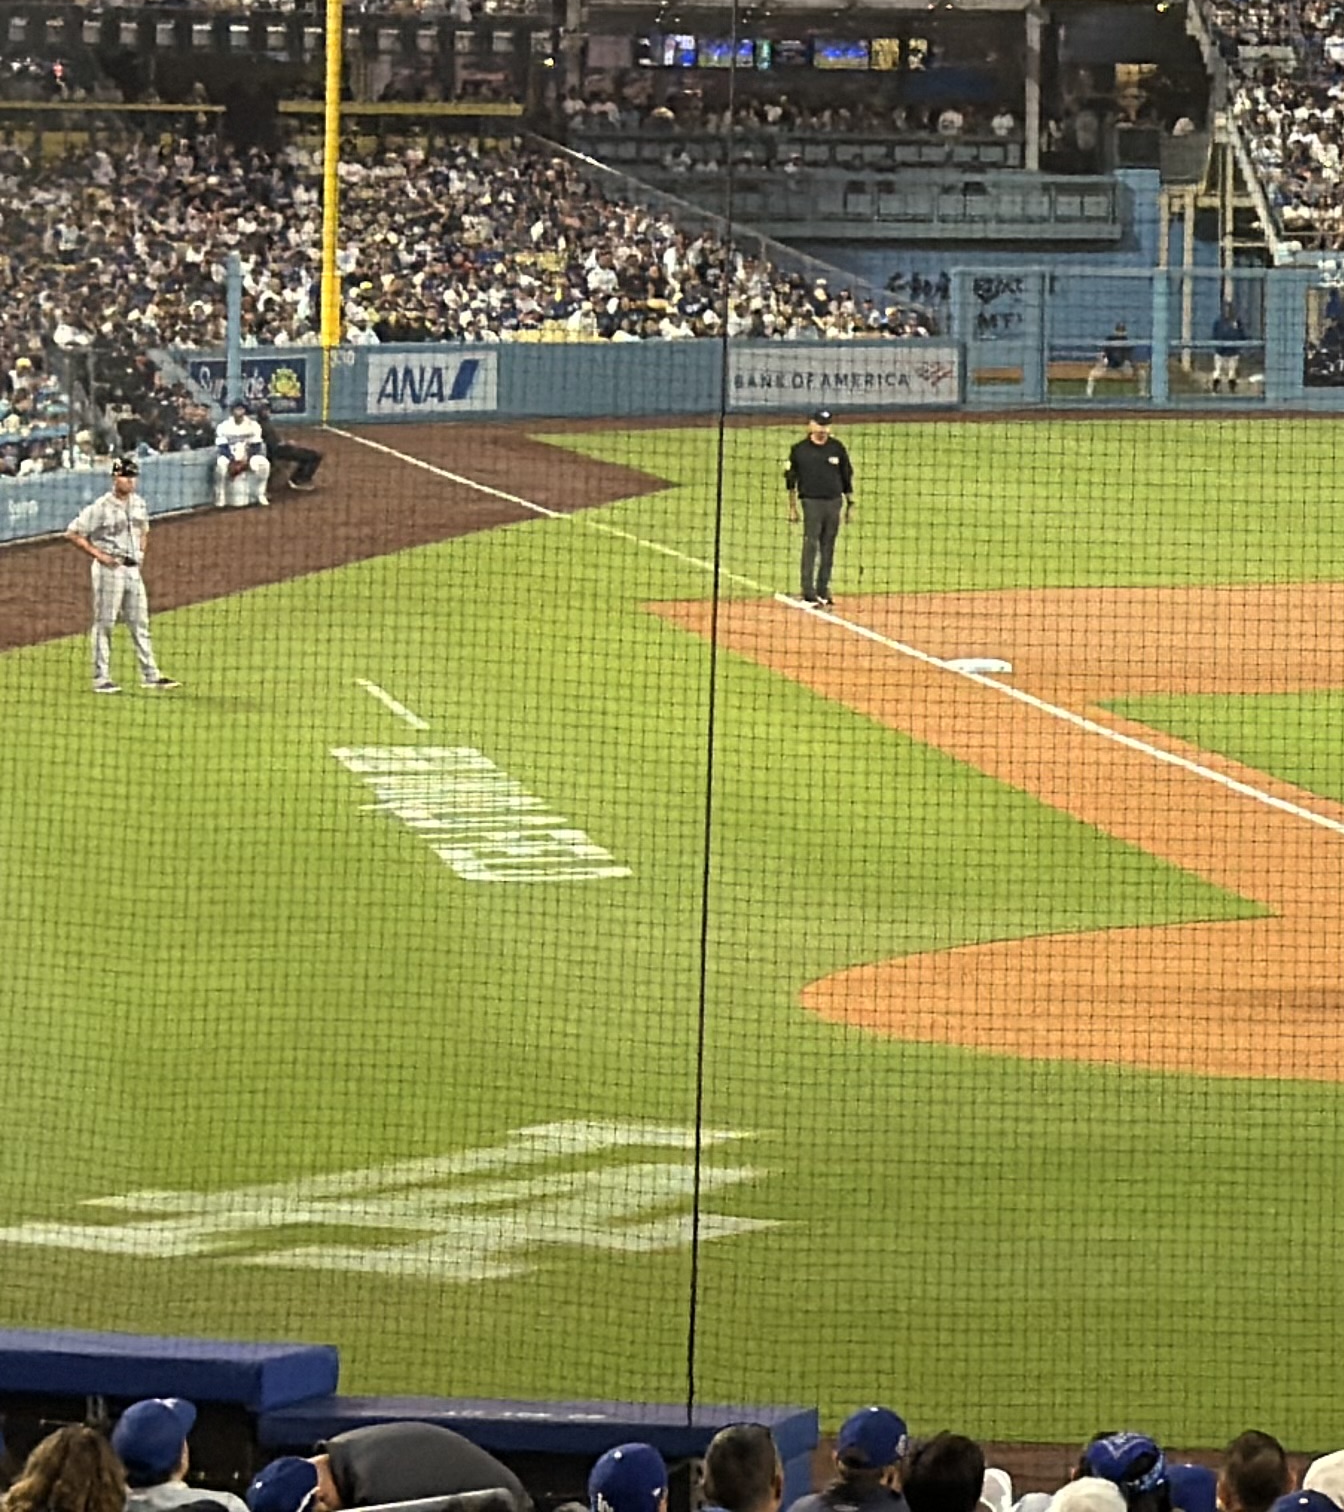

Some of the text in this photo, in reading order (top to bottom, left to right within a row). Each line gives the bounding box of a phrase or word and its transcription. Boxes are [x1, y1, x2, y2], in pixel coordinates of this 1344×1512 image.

[376, 365, 446, 404] ANA
[734, 374, 910, 389] BANK OF AMERICA
